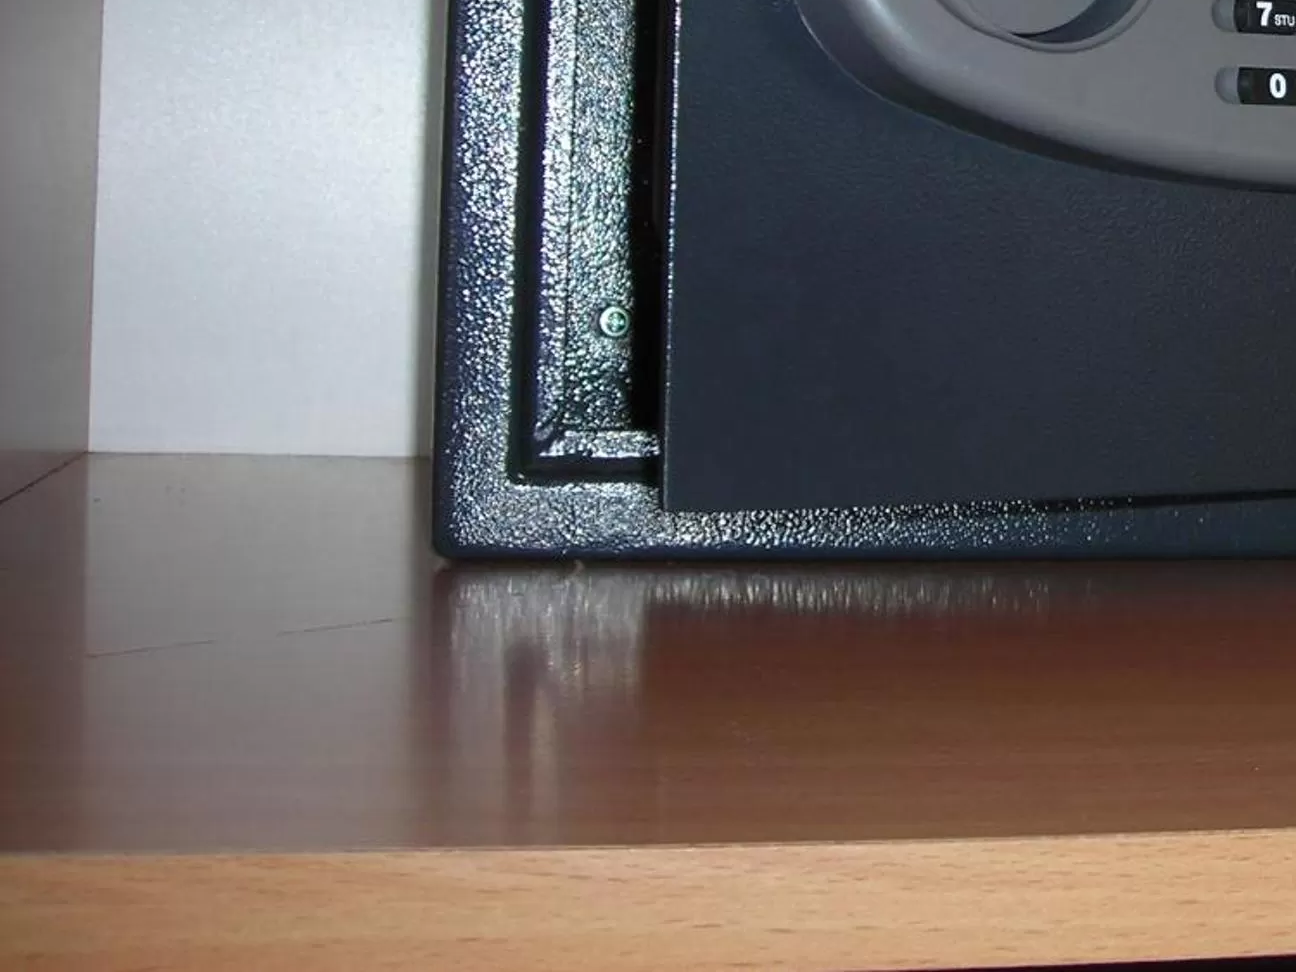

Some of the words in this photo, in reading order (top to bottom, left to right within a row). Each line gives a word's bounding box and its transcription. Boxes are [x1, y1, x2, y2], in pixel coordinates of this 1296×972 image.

[1256, 1, 1273, 27] 7
[1274, 14, 1295, 27] STU
[1269, 73, 1286, 99] 0
